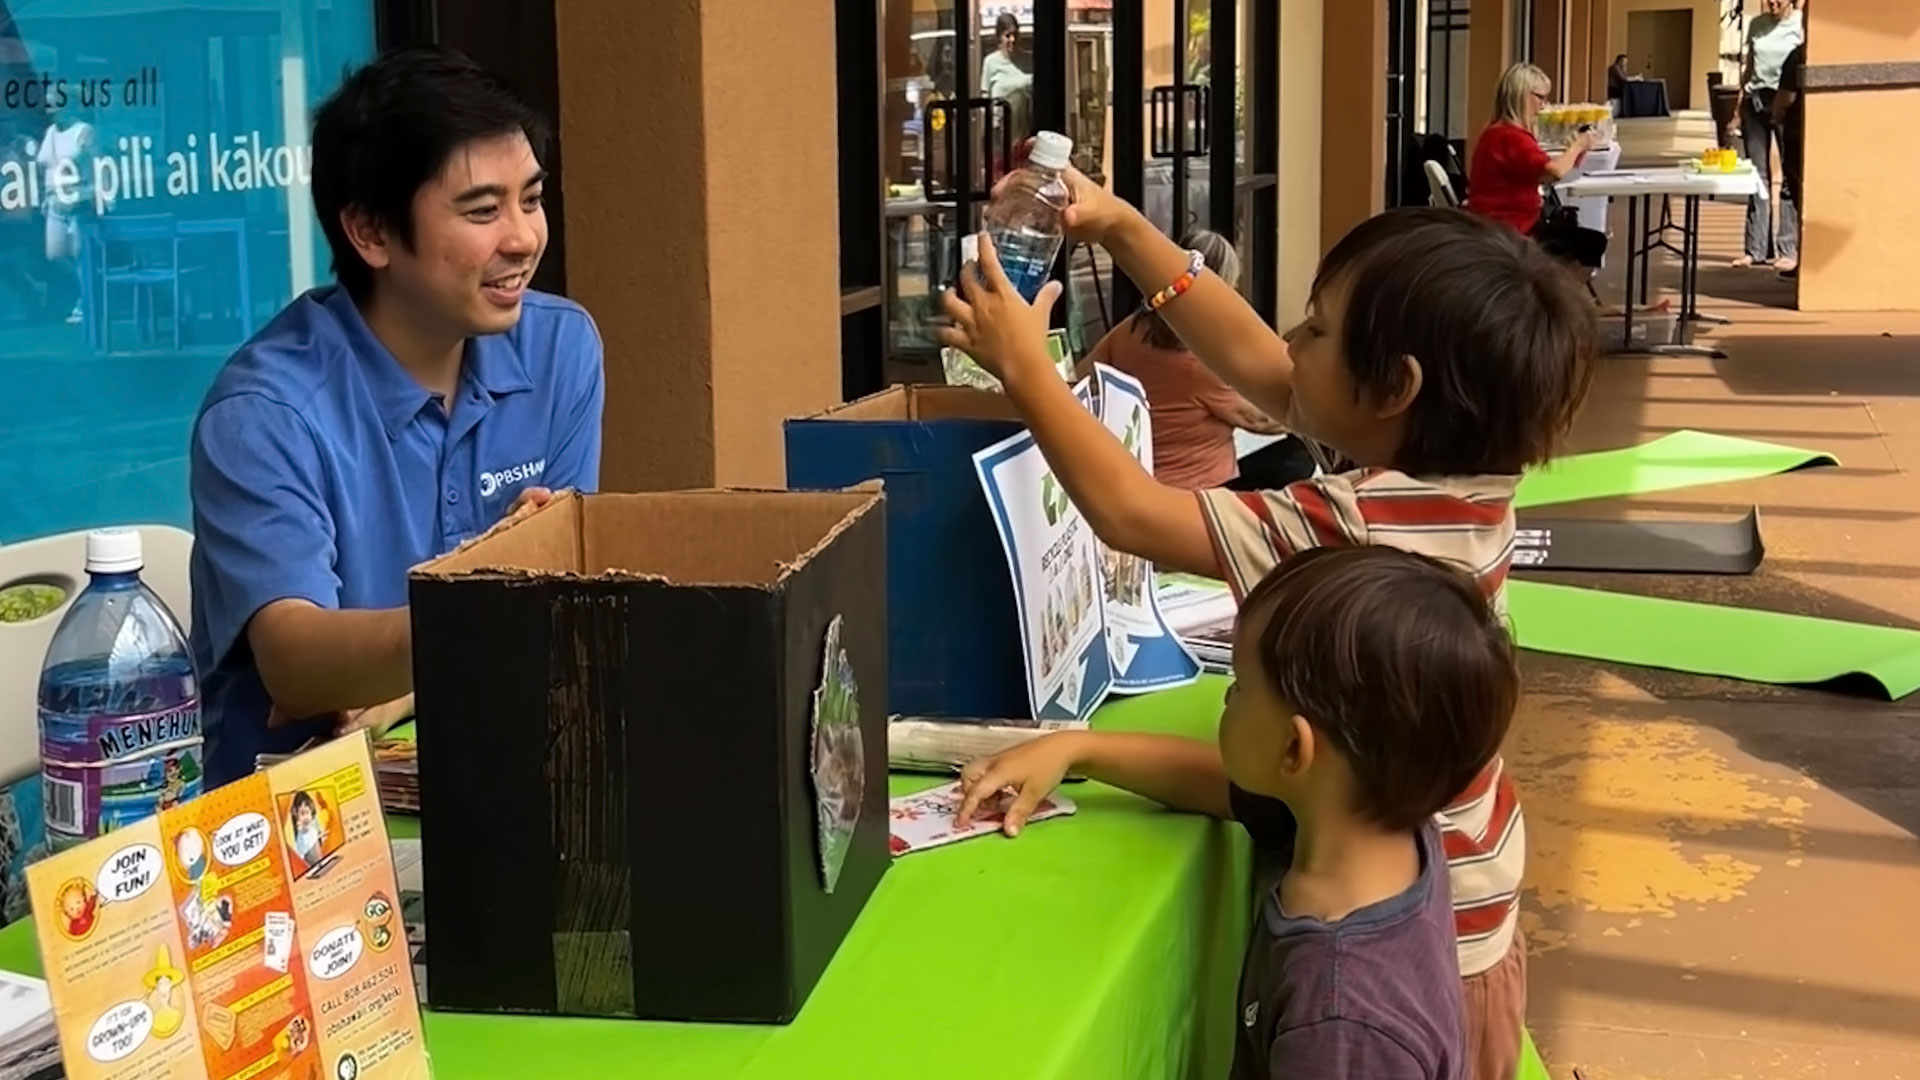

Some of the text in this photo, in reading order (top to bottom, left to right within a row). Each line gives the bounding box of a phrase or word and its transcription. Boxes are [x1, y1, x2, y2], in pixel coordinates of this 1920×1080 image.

[5, 67, 157, 108] ects us all
[0, 131, 312, 216] ai e pili ai kākou
[495, 466, 523, 487] PBS
[214, 832, 233, 848] LOOK
[247, 818, 265, 834] WHAT
[220, 831, 265, 860] YOU GET!
[111, 848, 147, 874] JOIN
[123, 864, 140, 878] THE
[115, 871, 150, 897] FUN!
[313, 931, 356, 961] DONATE
[324, 951, 354, 976] JOIN!
[320, 997, 343, 1015] CALL
[92, 1010, 148, 1048] GROWN-UPS
[111, 1032, 134, 1054] TOO!
